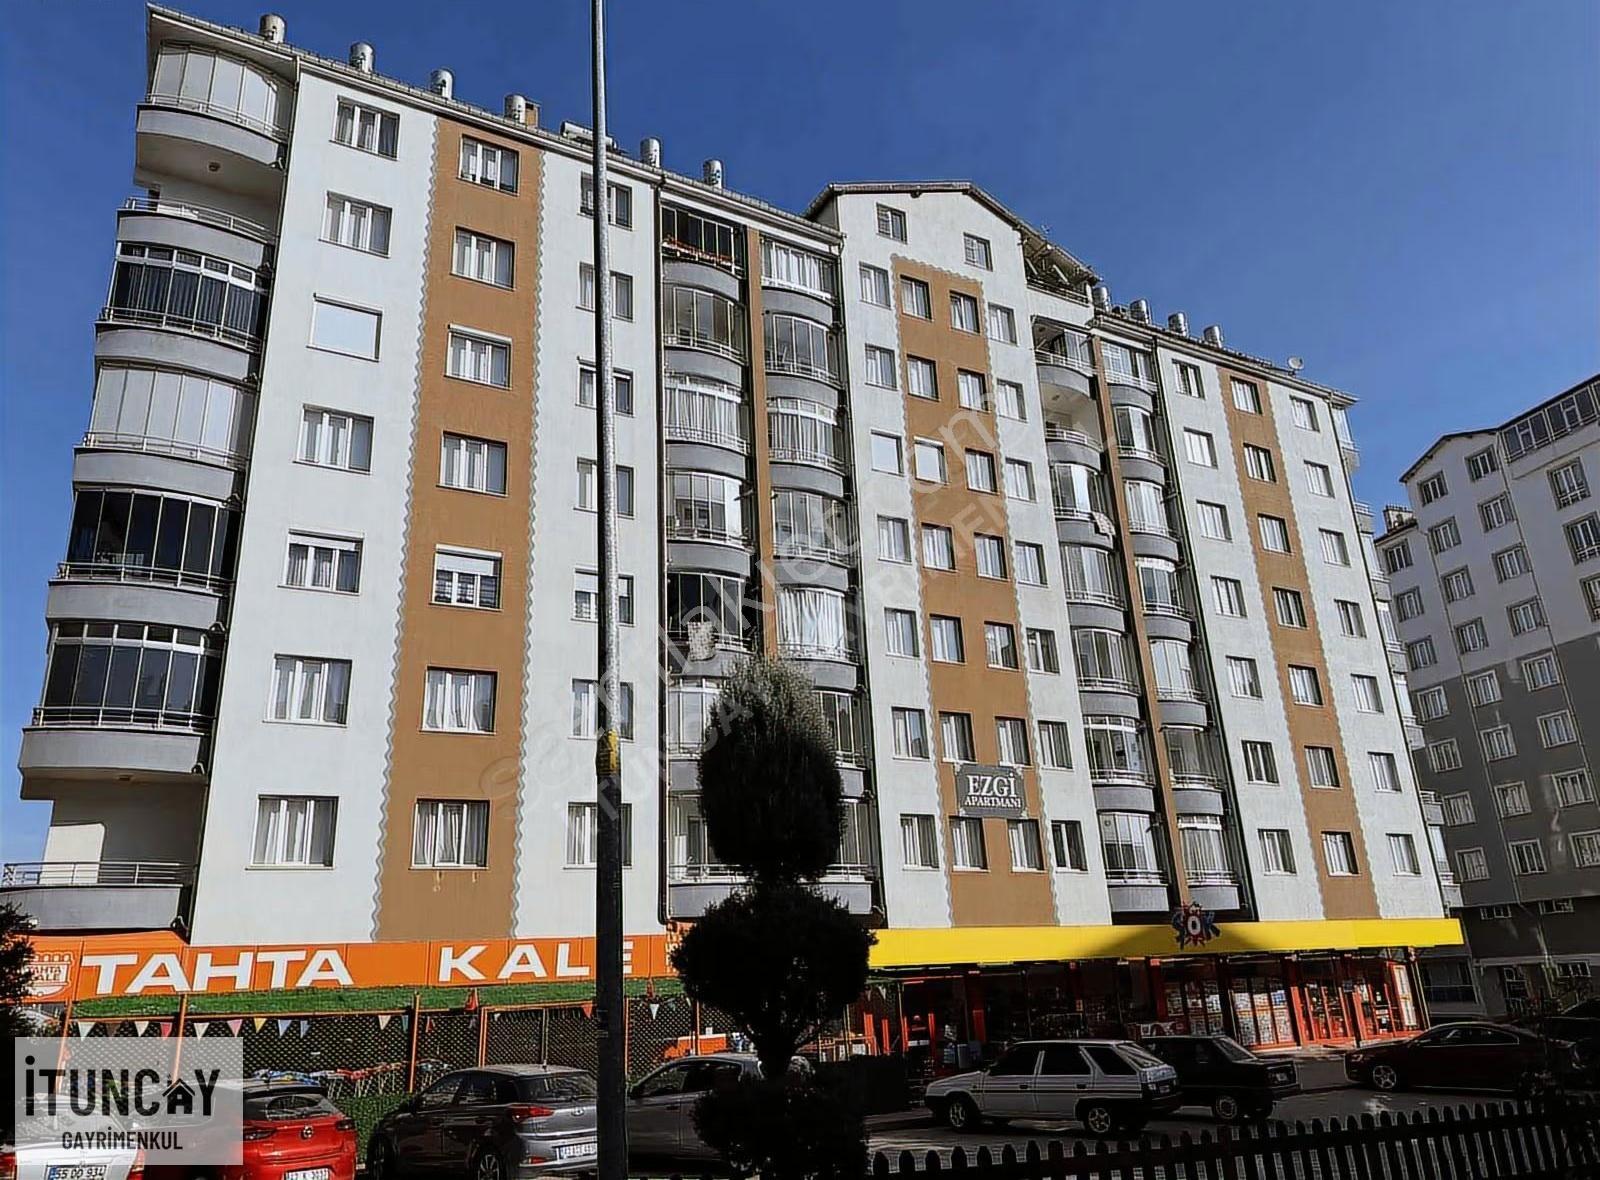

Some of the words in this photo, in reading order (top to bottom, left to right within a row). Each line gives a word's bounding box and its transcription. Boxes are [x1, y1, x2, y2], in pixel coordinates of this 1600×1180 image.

[966, 772, 1017, 798] EZGİ
[964, 796, 1022, 808] APARTMANI
[82, 949, 354, 995] TAHTA
